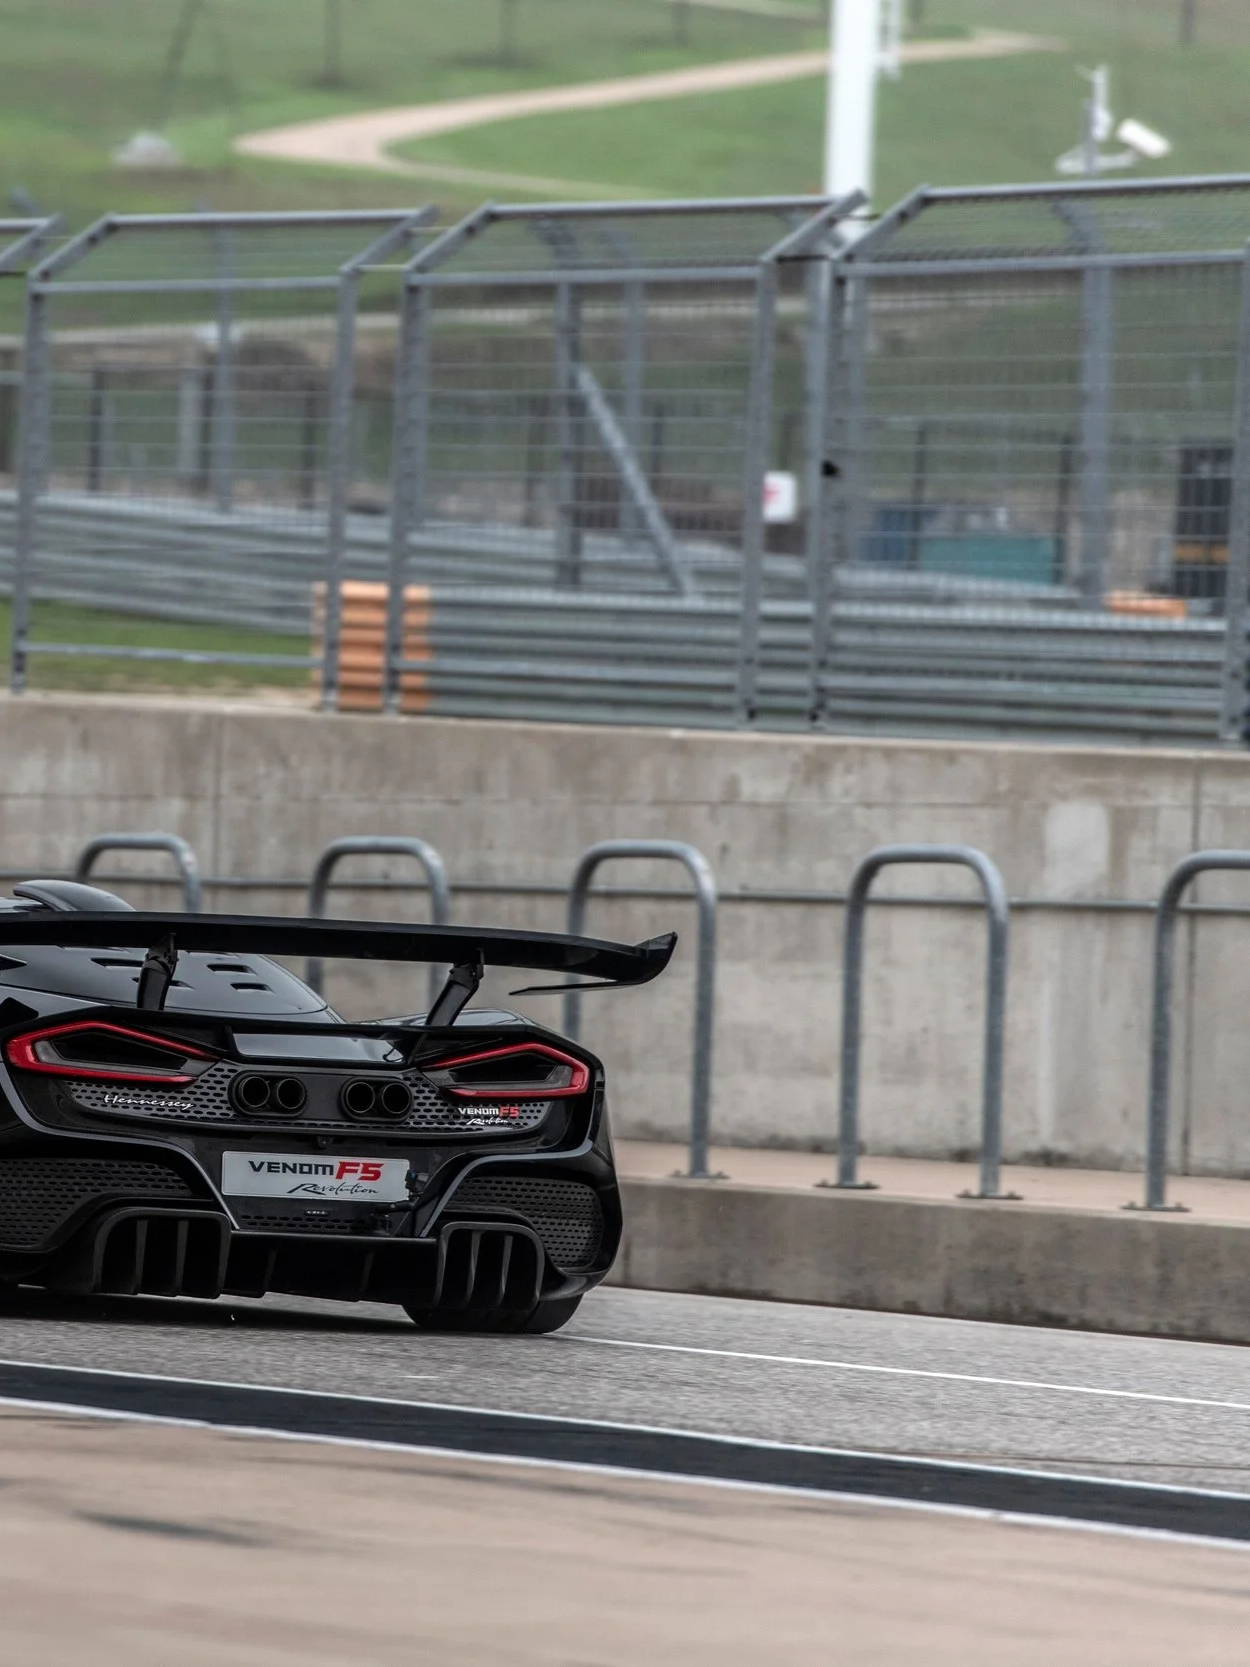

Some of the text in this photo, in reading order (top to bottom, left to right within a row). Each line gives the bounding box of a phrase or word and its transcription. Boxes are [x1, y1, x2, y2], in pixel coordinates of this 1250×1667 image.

[104, 1094, 194, 1110] Hennessey
[248, 1160, 385, 1181] VENOM F5
[286, 1181, 379, 1196] Revolution
